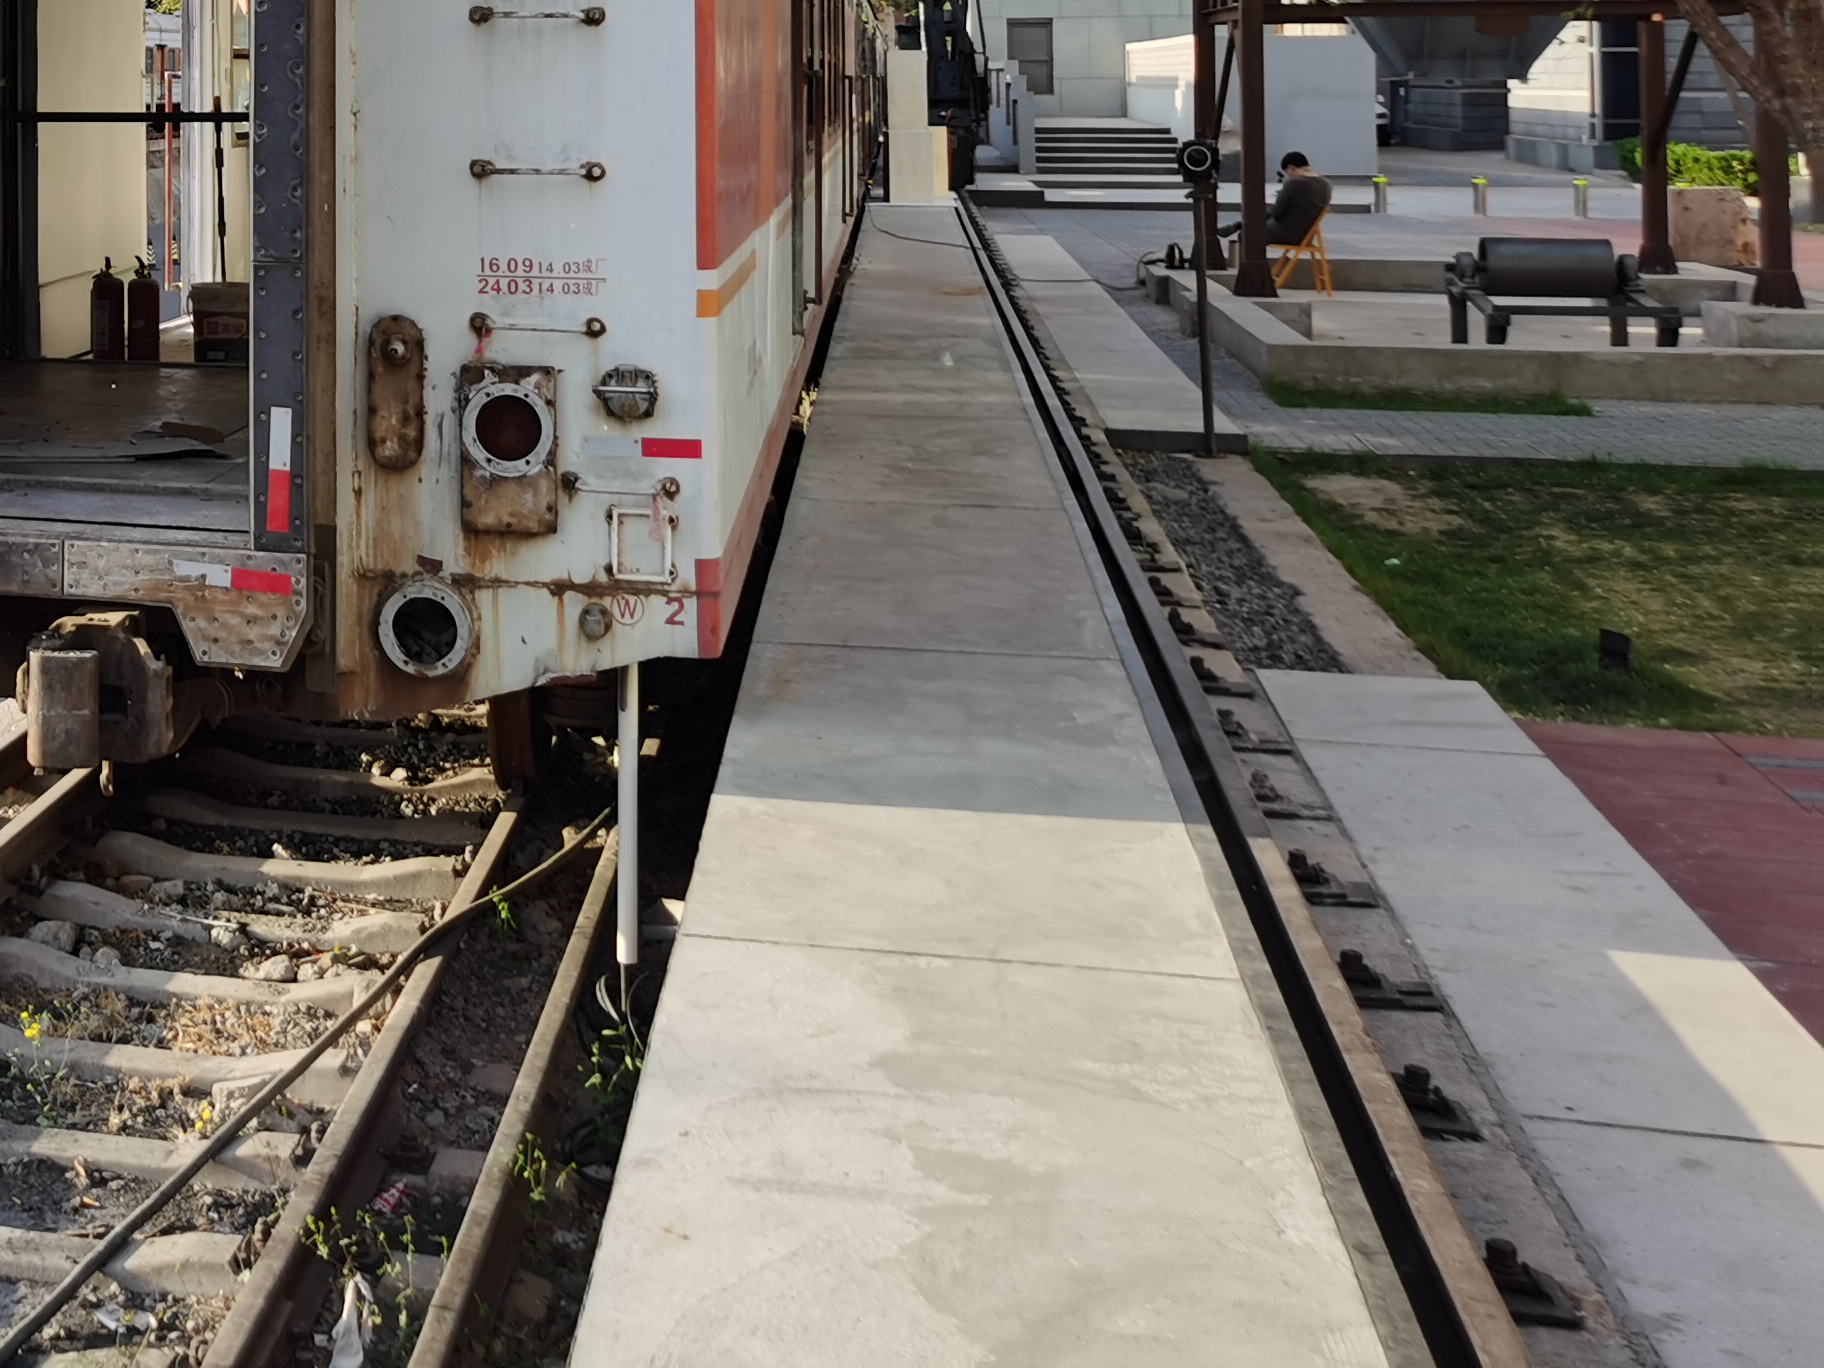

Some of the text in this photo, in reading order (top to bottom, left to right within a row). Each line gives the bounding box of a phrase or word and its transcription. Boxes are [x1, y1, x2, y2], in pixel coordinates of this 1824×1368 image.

[479, 256, 534, 274] 16.09
[477, 277, 534, 295] 24.03
[616, 597, 685, 626] W 2
